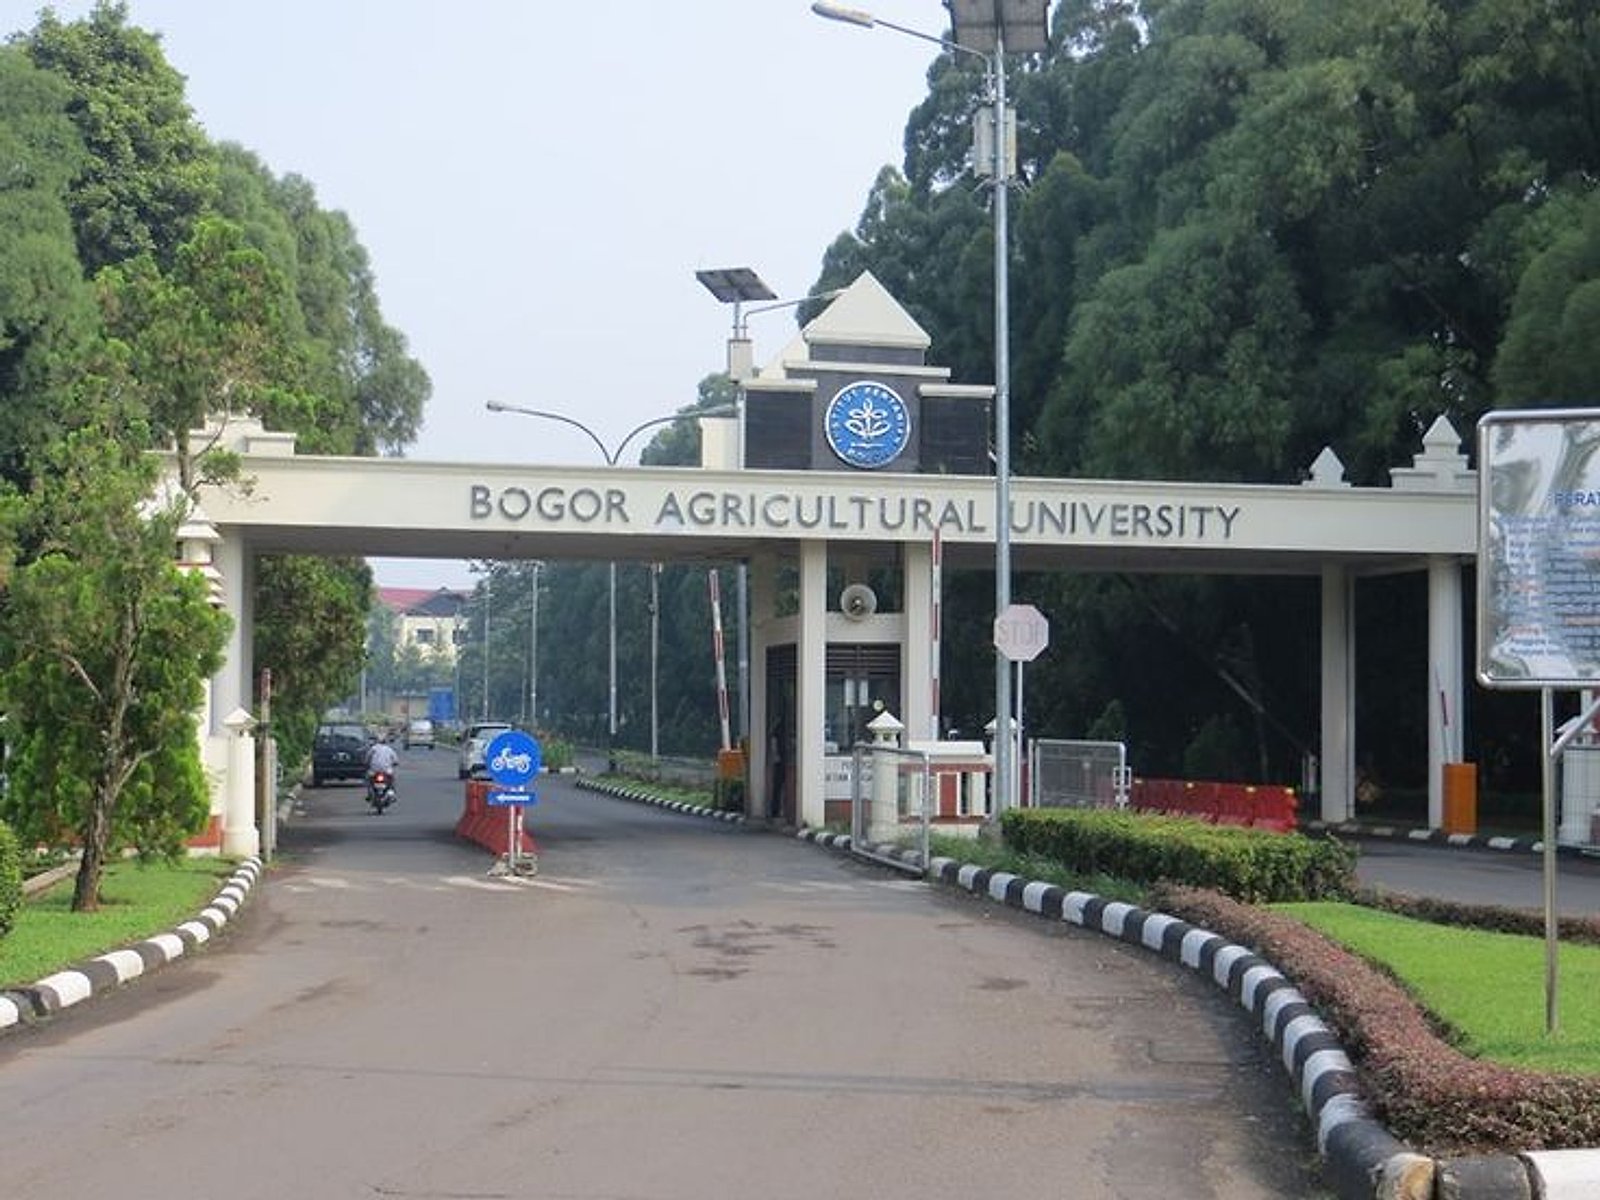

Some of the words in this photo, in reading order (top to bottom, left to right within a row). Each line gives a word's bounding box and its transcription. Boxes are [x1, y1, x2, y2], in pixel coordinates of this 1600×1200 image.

[470, 485, 629, 522] BOGOR
[656, 491, 986, 533] AGRICULTURAL
[1010, 501, 1240, 538] UNIVERSITY
